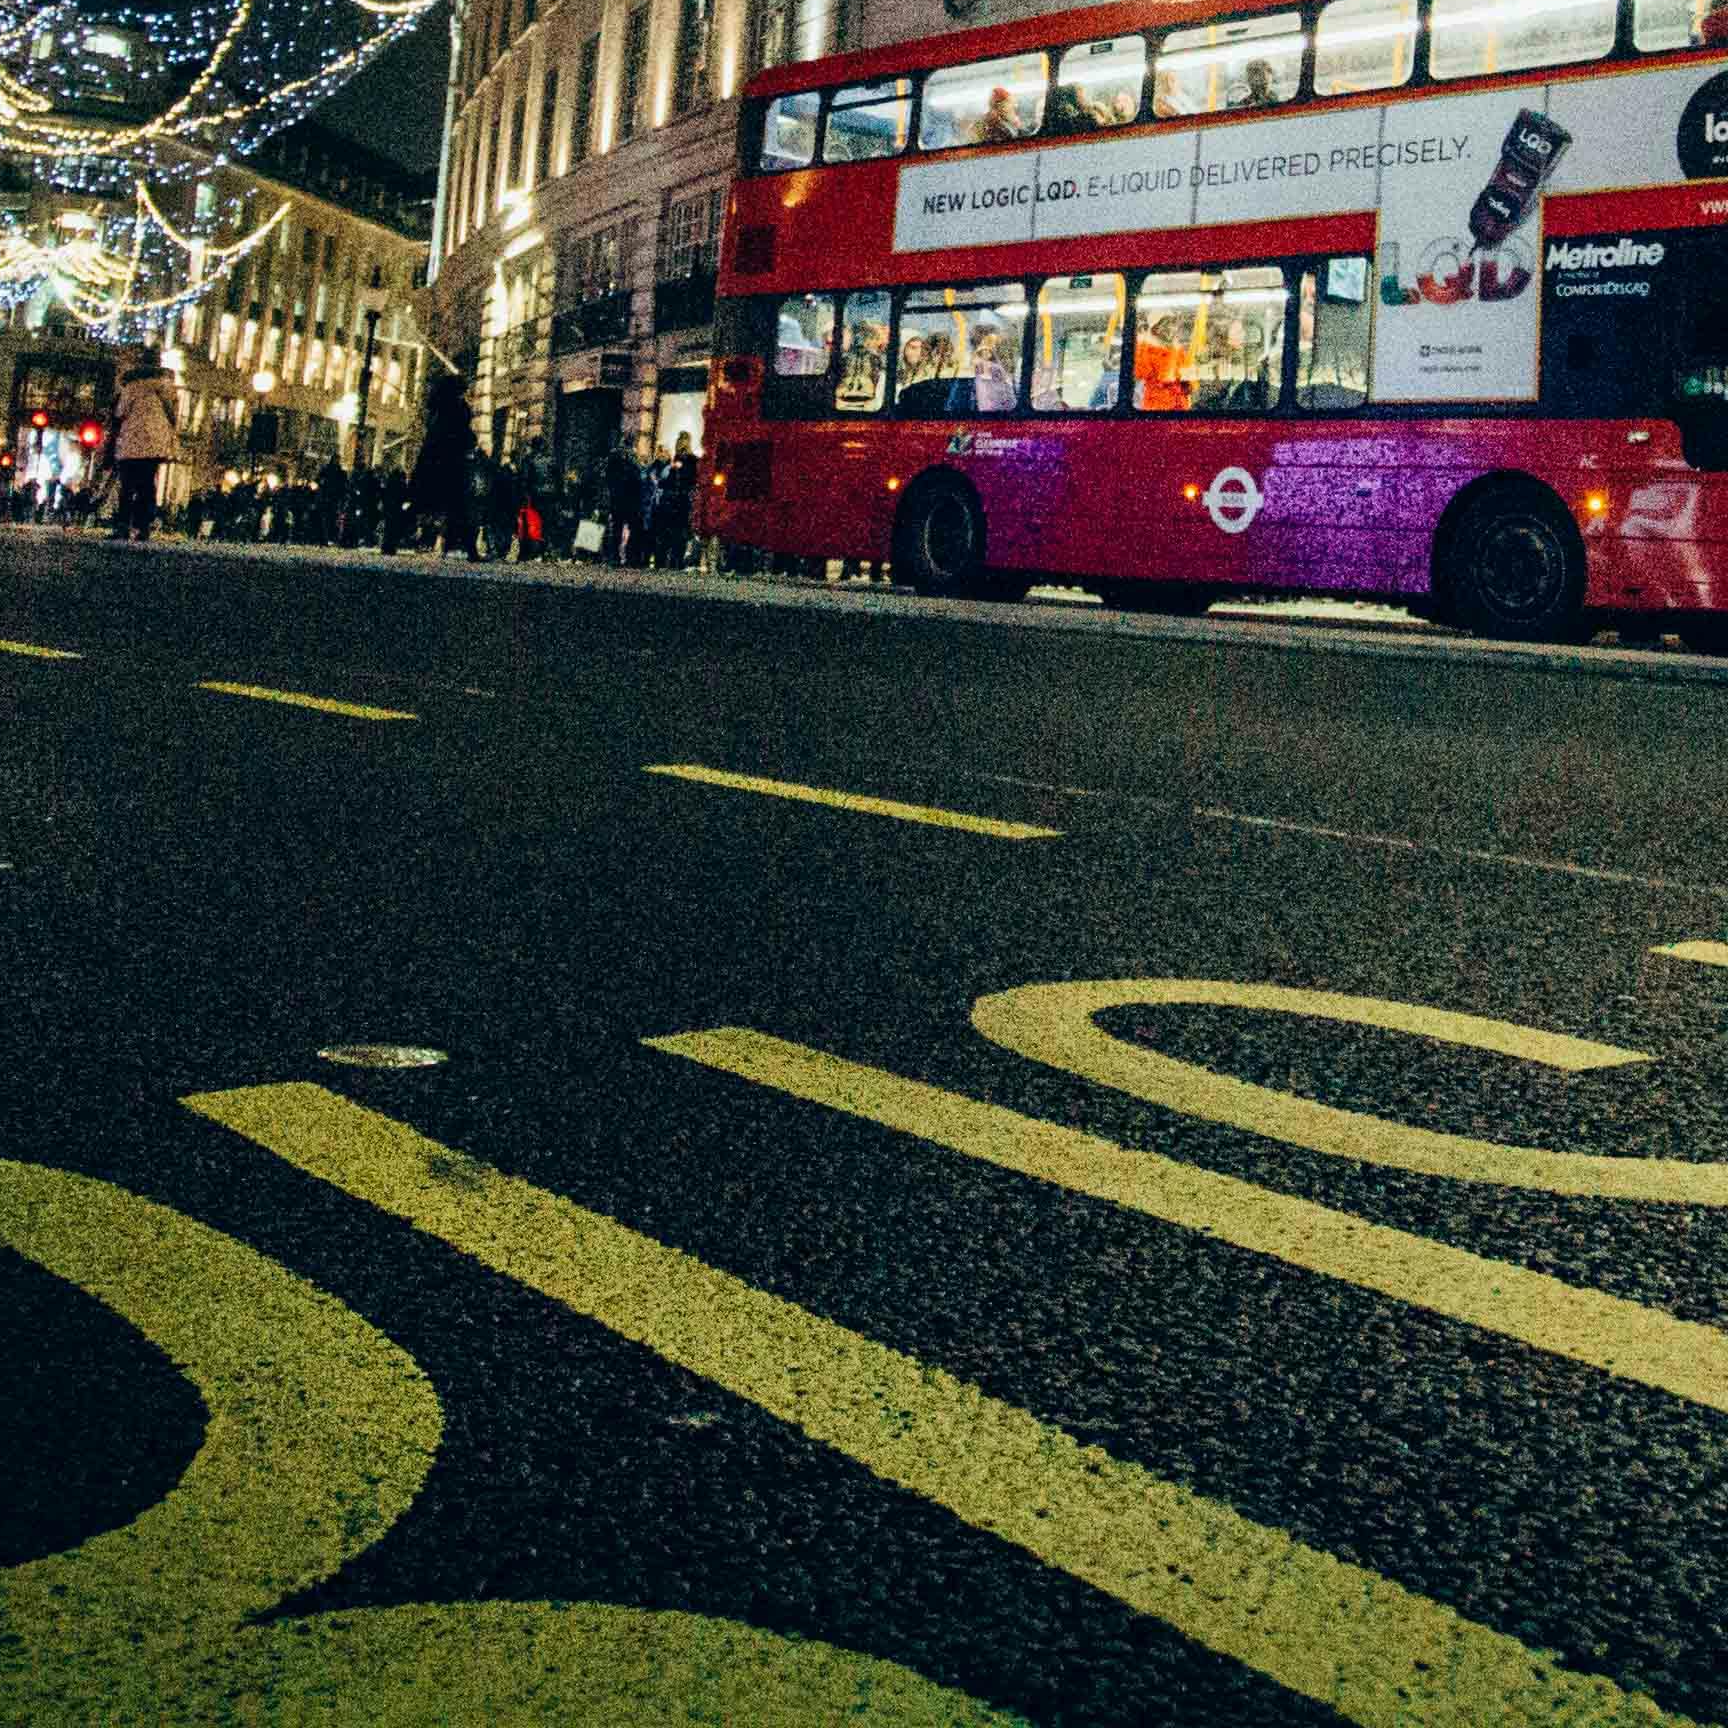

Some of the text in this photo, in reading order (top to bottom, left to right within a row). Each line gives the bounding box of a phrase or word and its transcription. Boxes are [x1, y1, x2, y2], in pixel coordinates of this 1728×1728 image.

[923, 135, 1472, 215] NEW LOGIC LQD. E-LIQUID DELIVERED PRECISELY.
[1380, 236, 1536, 306] LQD
[1544, 238, 1665, 272] Metroline
